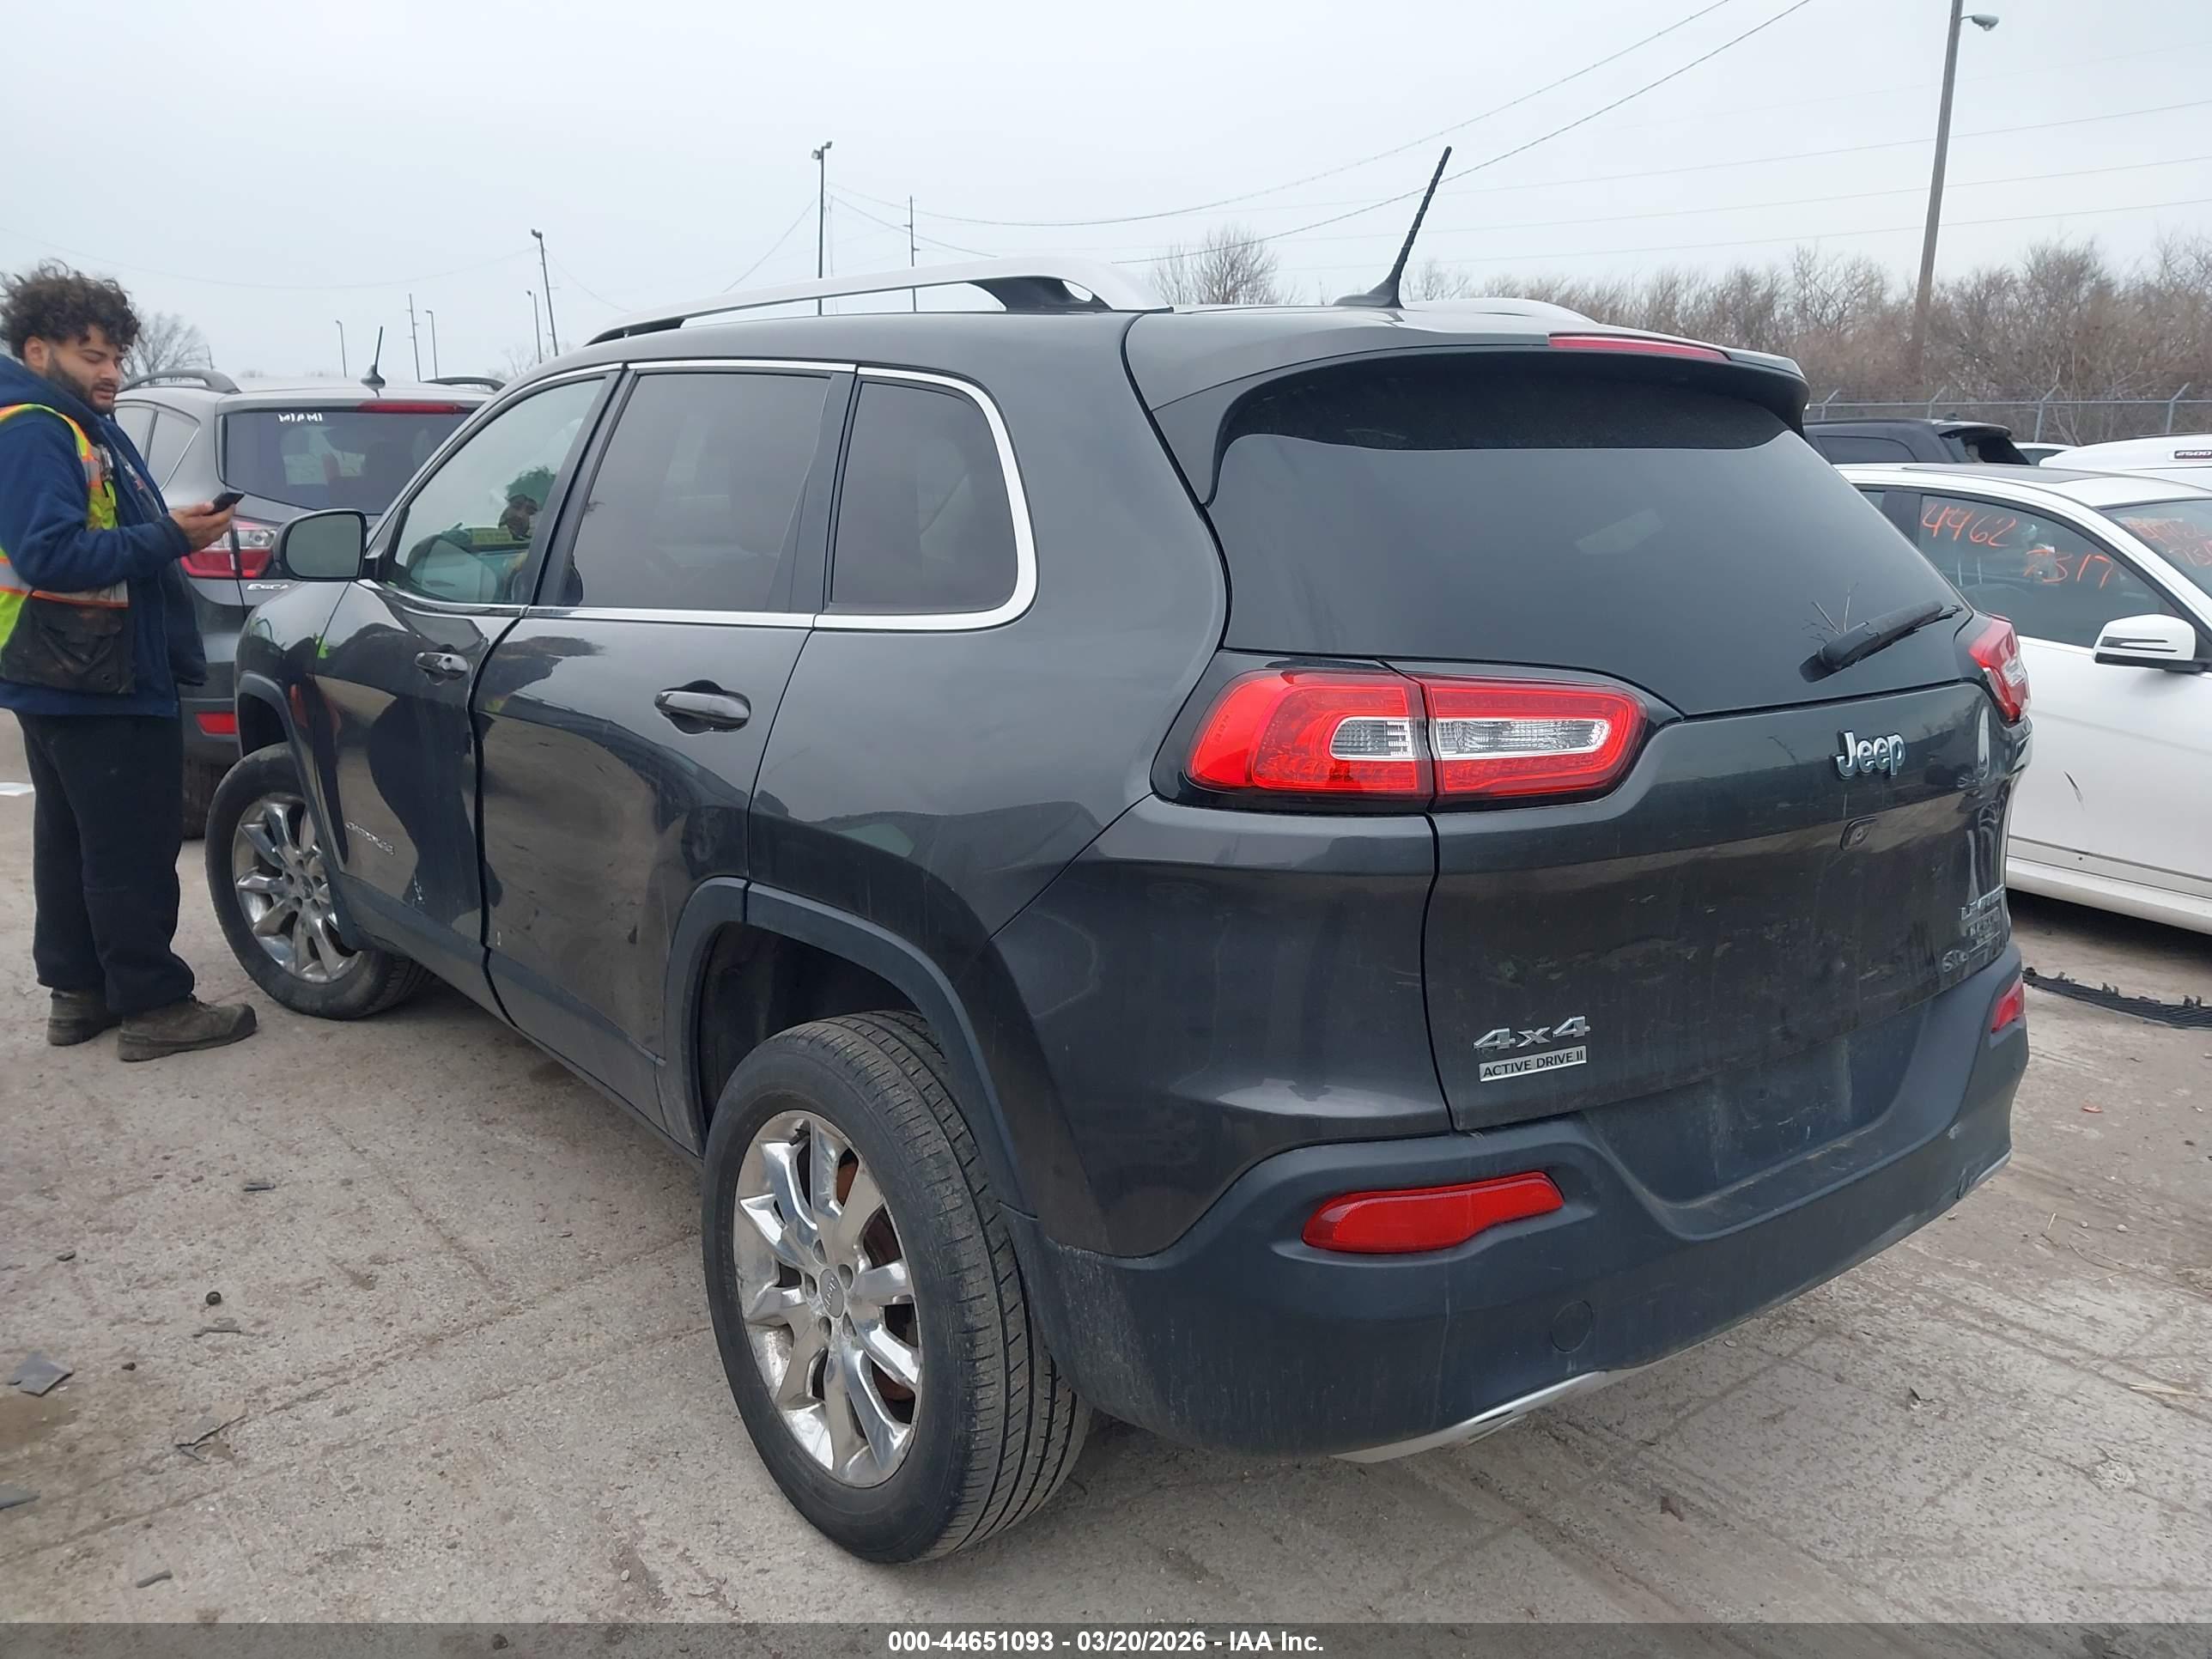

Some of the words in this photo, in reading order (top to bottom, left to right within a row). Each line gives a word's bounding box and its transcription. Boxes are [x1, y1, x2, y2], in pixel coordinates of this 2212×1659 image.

[1922, 504, 2017, 547] 4462
[1834, 731, 1906, 777] Jeep
[1483, 1059, 1533, 1078] ACTIVE
[1536, 1051, 1574, 1068] DRIVE
